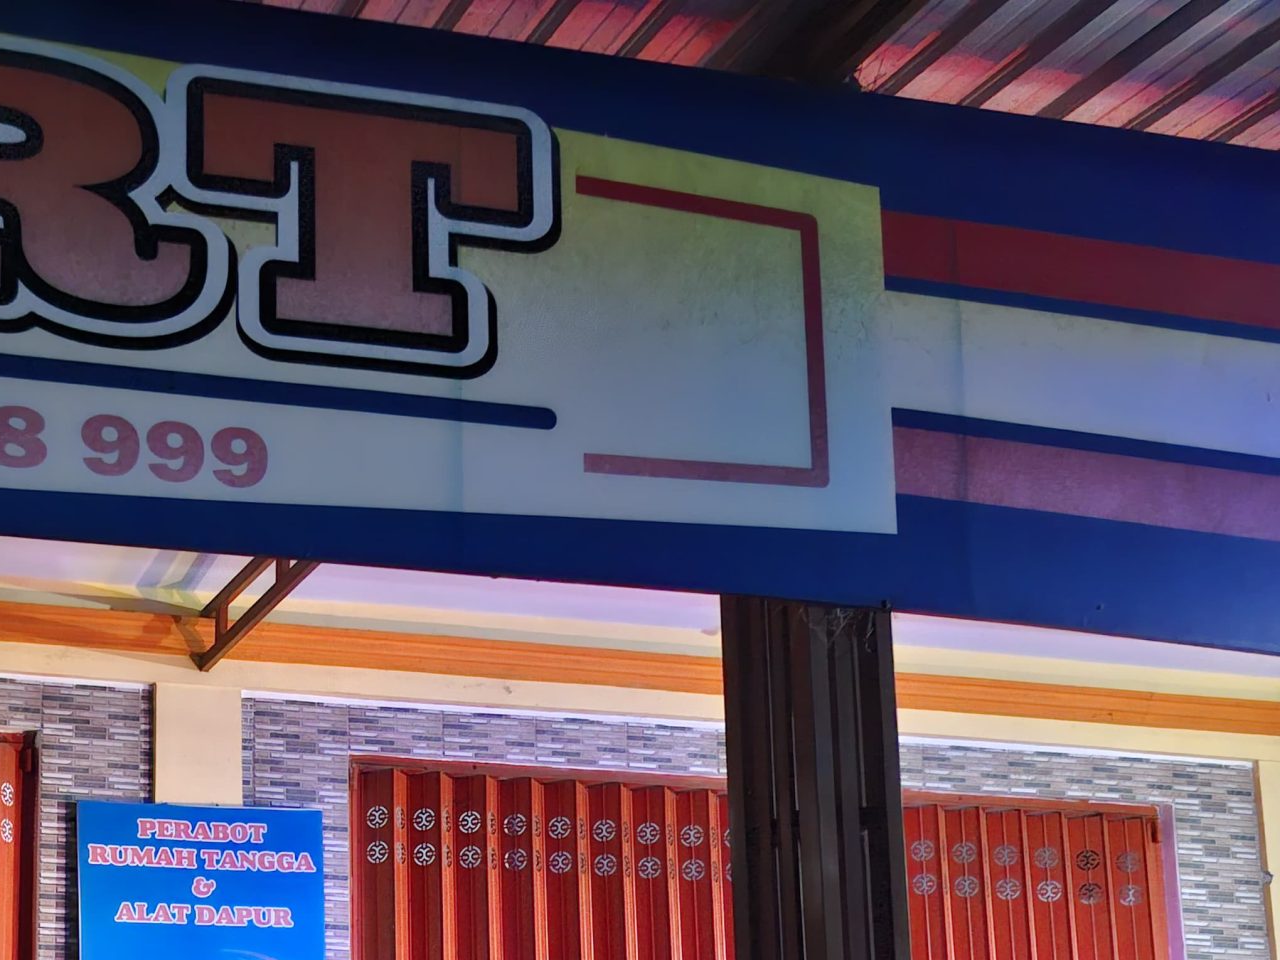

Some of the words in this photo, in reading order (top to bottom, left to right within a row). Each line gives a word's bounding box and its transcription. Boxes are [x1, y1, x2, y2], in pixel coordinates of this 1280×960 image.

[81, 414, 268, 488] 999
[137, 818, 267, 843] PERABOT
[88, 844, 197, 869] RUMAH
[201, 850, 316, 872] TANGGA
[192, 877, 216, 897] &
[114, 901, 191, 925] ALAT
[194, 905, 294, 928] DAPUR
